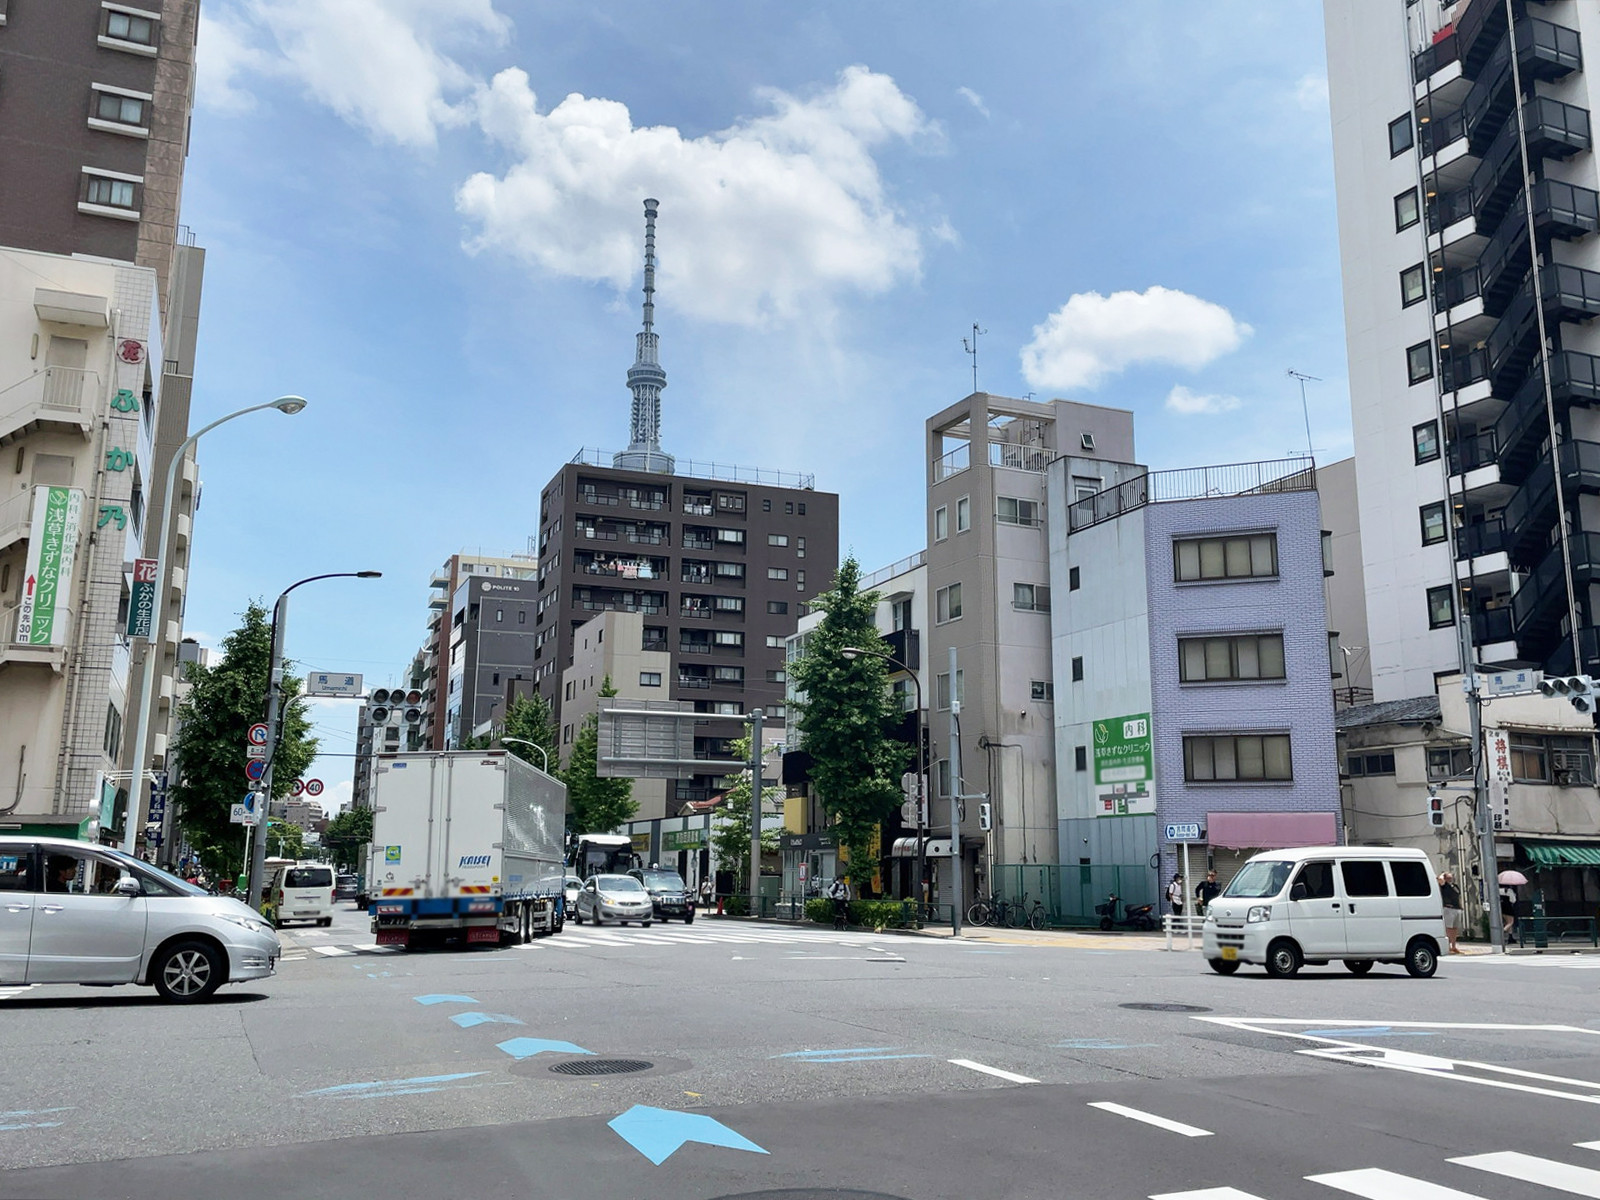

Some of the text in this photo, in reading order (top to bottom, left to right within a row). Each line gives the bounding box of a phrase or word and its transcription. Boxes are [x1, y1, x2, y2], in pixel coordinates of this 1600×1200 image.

[33, 508, 65, 643] 浅草きずなクリニック
[138, 562, 157, 582] 花
[134, 583, 154, 635] ふかの生花店
[1125, 721, 1146, 737] 内科
[310, 783, 321, 792] 40
[459, 855, 491, 868] KAISEI
